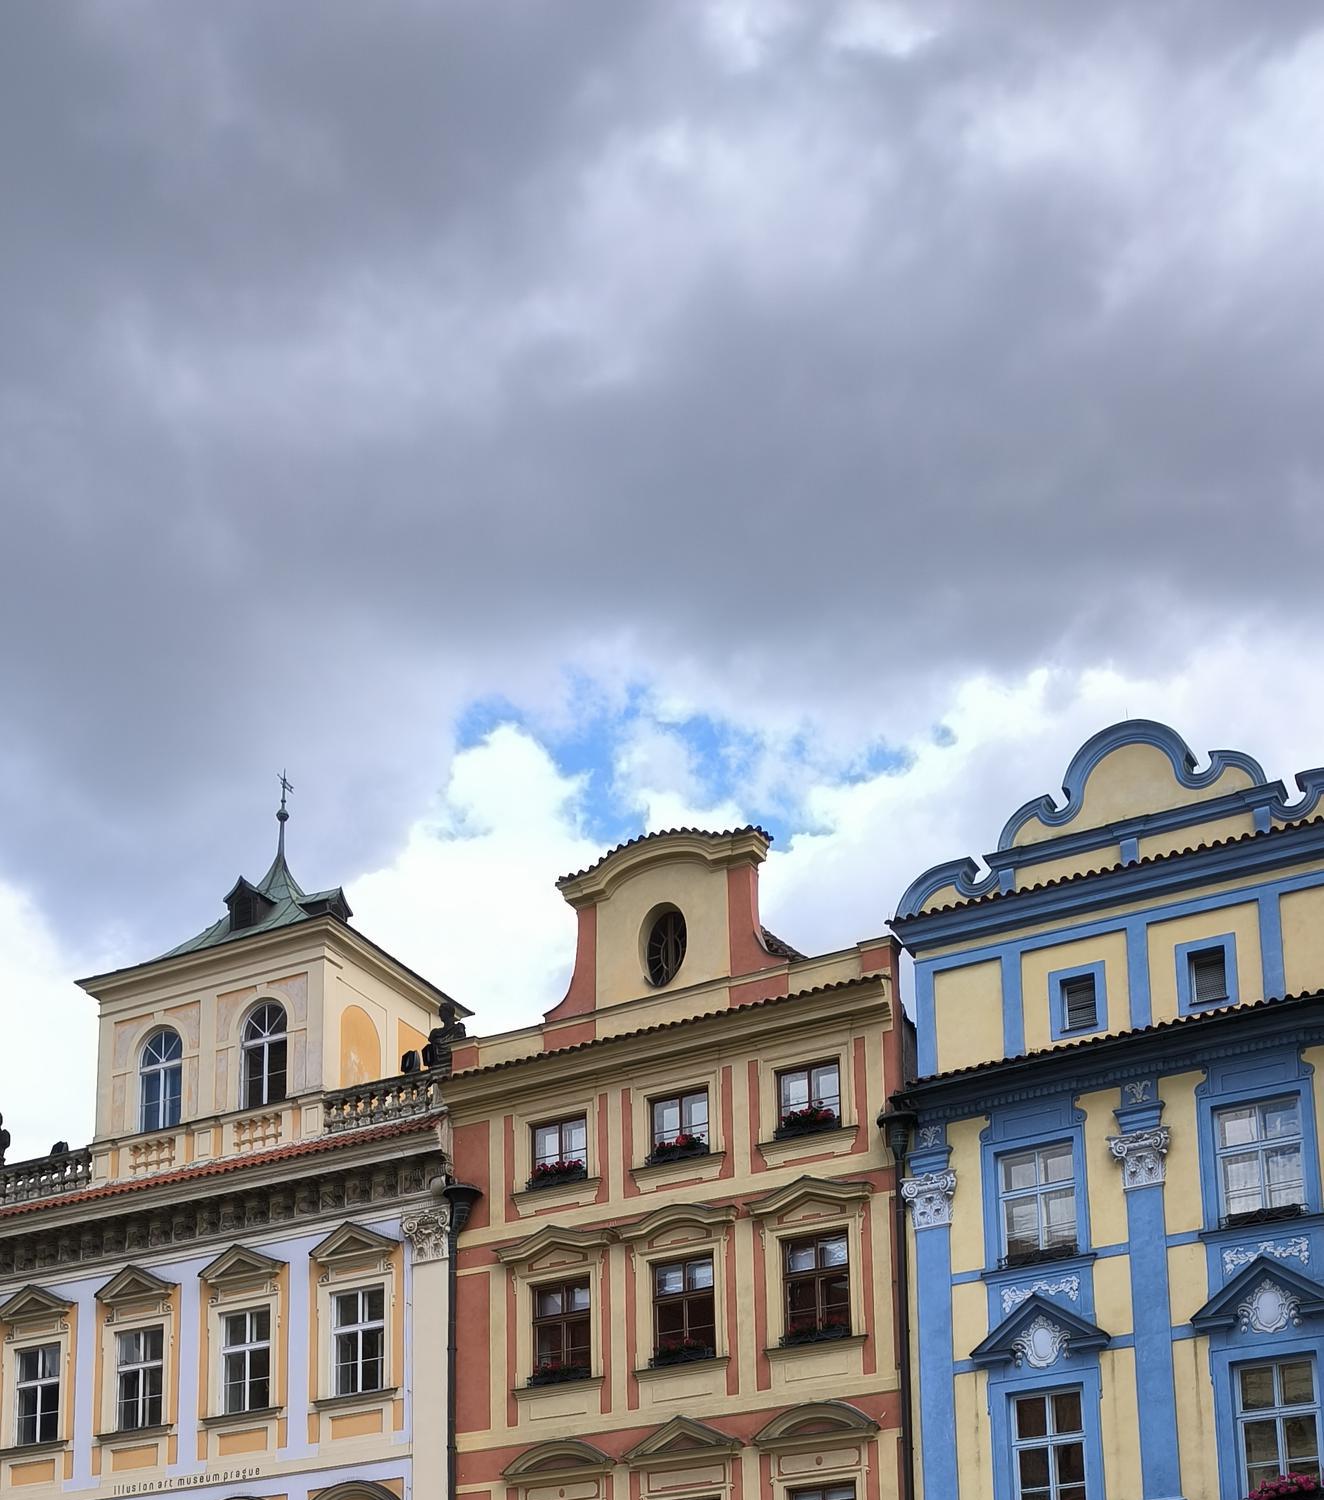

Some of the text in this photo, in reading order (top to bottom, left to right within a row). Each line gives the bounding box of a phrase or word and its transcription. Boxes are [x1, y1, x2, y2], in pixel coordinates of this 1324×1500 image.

[157, 1479, 173, 1489] art
[177, 1473, 220, 1487] museum
[223, 1467, 261, 1482] prague
